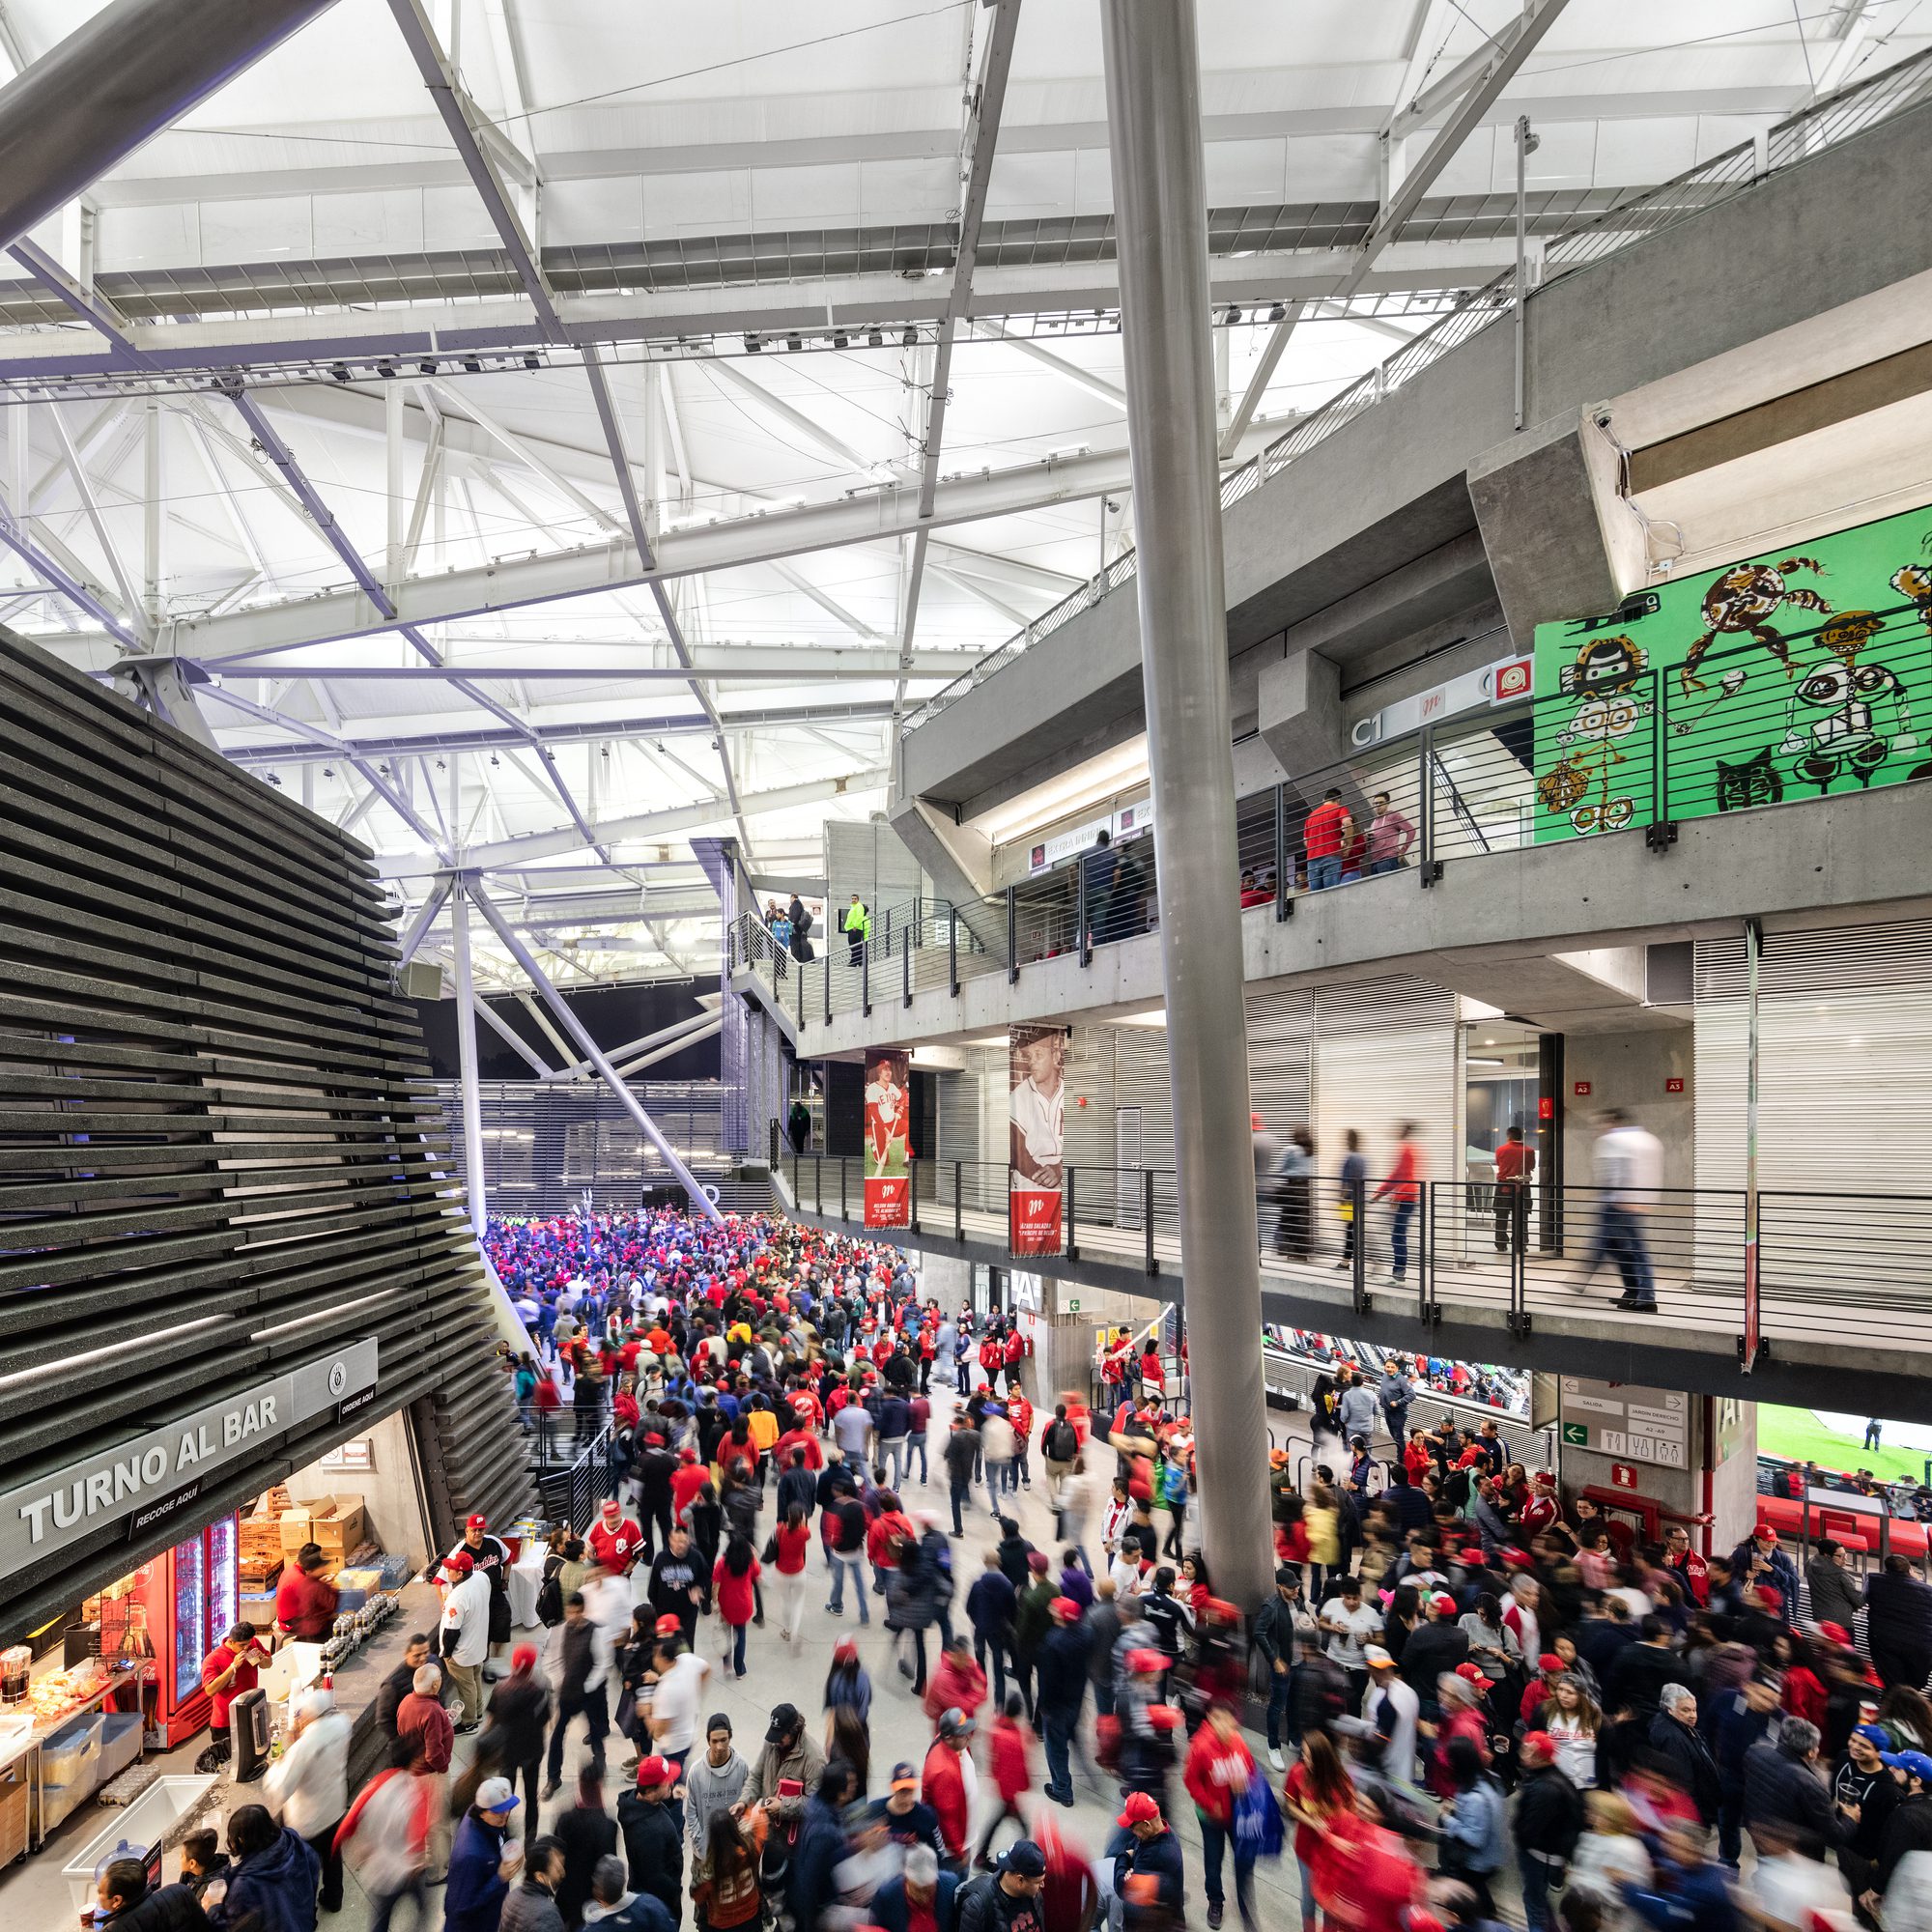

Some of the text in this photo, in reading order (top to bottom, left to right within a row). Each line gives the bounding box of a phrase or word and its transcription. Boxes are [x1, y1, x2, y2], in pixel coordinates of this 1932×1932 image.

[1351, 712, 1383, 746] C1
[701, 1184, 721, 1206] D
[341, 1397, 362, 1415] ORDENE
[1582, 1400, 1604, 1408] SALIDA
[1652, 1412, 1680, 1422] DERECHO
[19, 1395, 278, 1544] TURNO AL BAR
[136, 1485, 199, 1528] RECOGE AQUÍ
